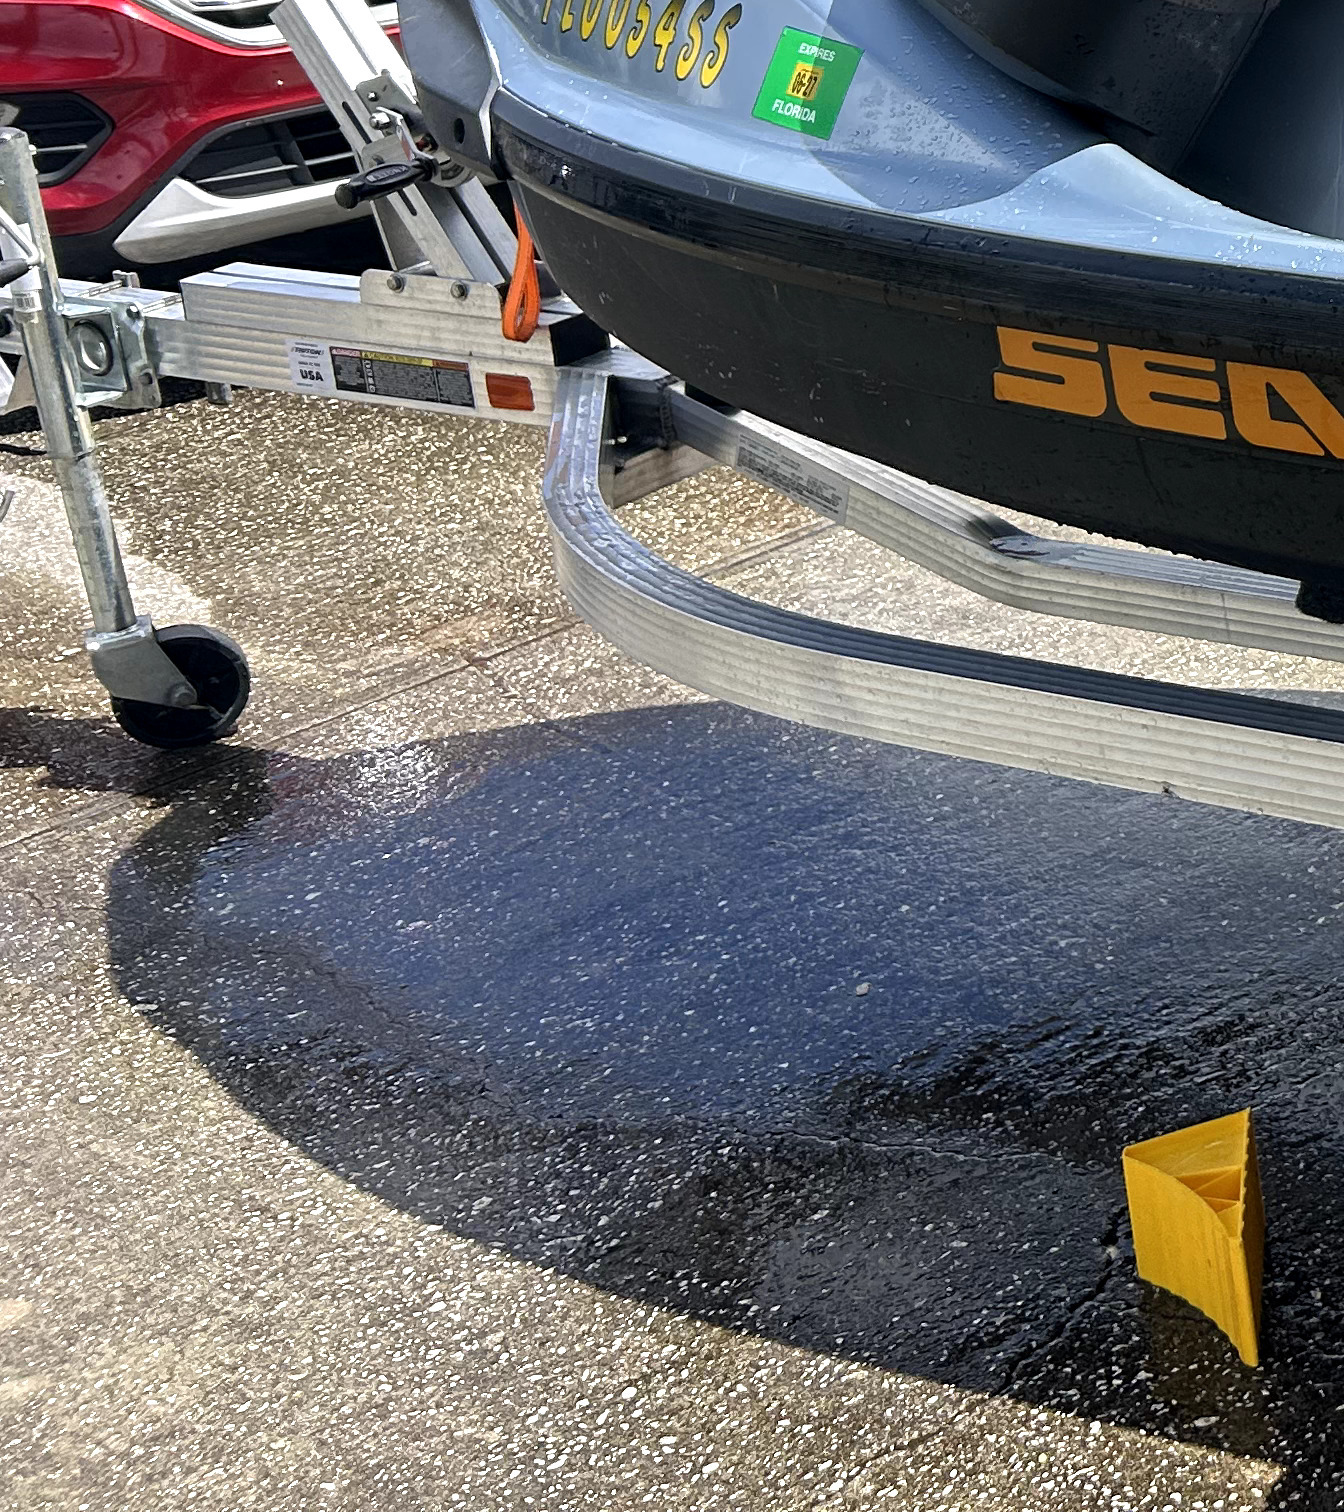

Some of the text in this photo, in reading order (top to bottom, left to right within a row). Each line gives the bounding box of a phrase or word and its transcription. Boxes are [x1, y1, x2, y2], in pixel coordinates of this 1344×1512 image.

[798, 42, 836, 62] EXPIRES
[771, 99, 816, 123] FLORIDA
[300, 369, 324, 382] USA
